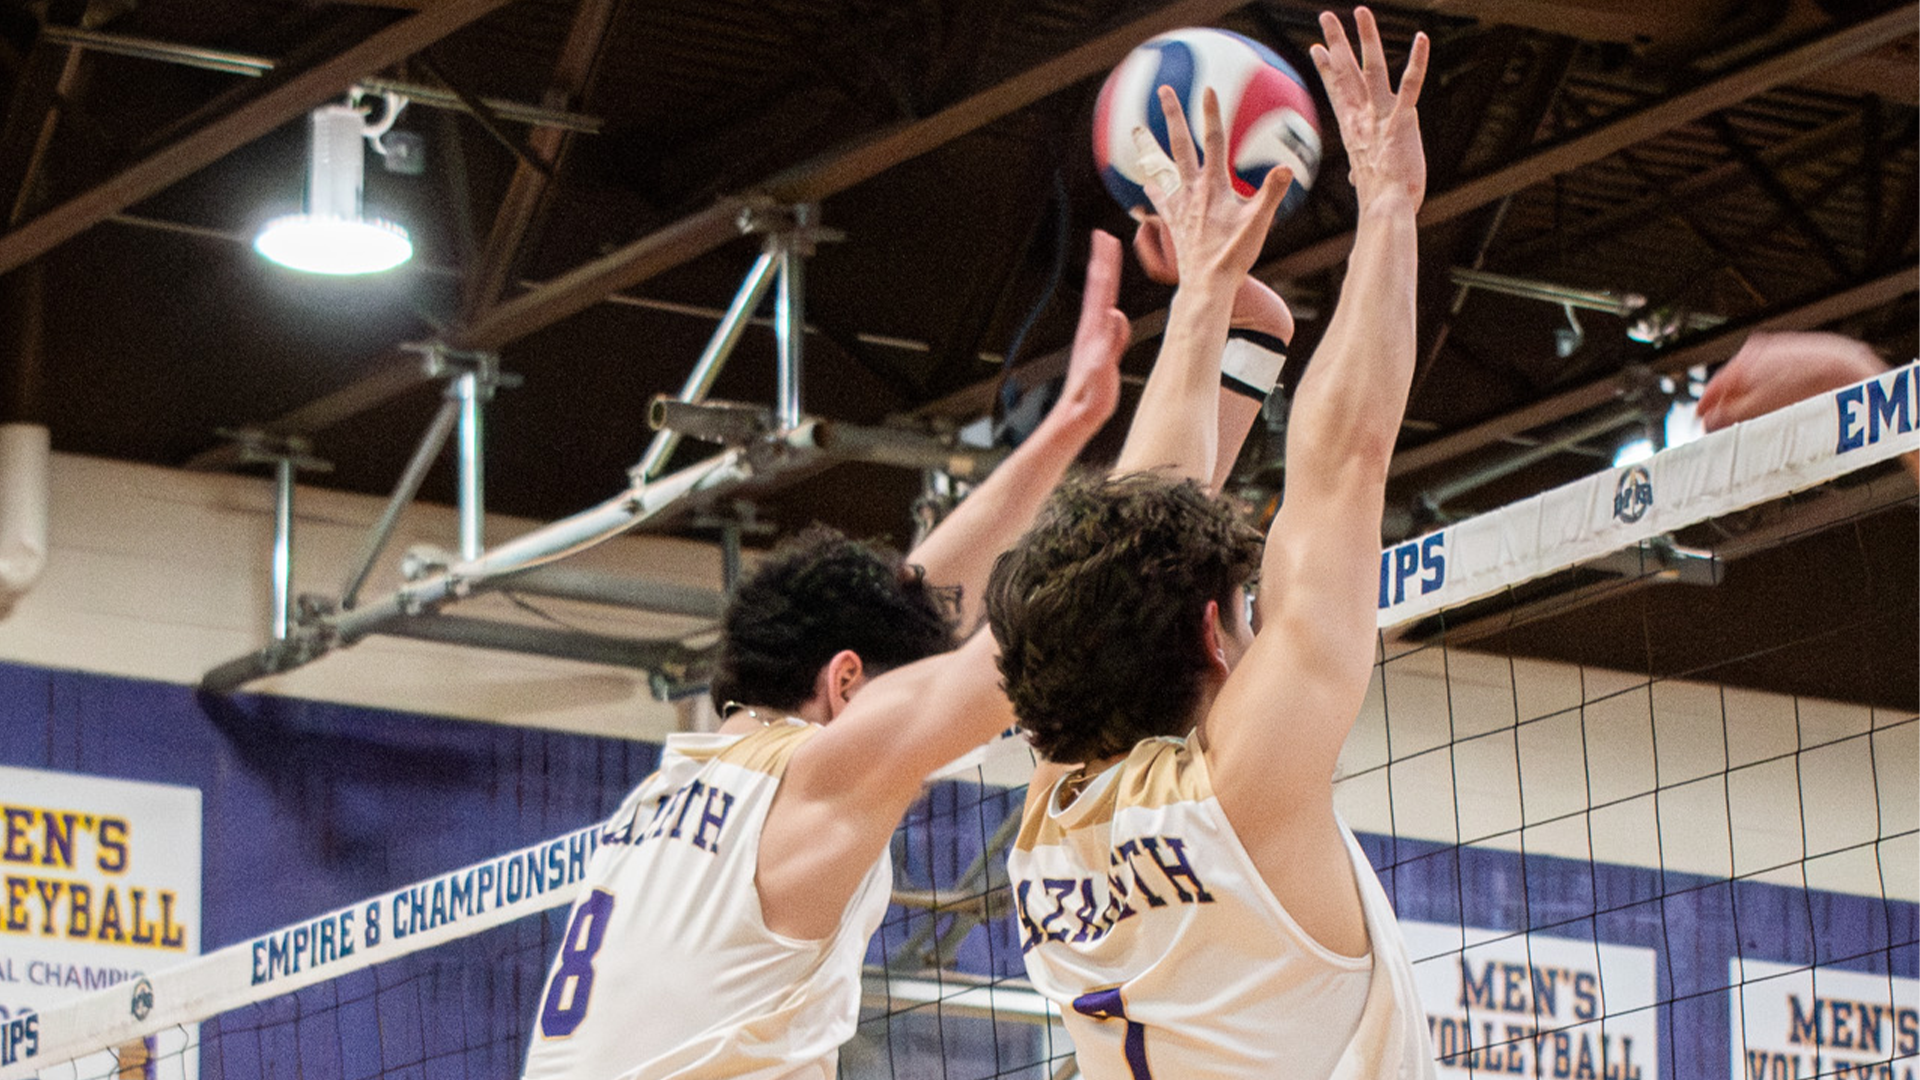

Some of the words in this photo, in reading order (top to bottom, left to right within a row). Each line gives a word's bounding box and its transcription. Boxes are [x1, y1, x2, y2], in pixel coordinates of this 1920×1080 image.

[250, 909, 356, 987] EMPIRE
[364, 900, 382, 949] 8
[392, 823, 607, 941] CHAMPIONSHI
[541, 887, 615, 1041] 8
[1458, 957, 1598, 1021] MEN'S
[1787, 992, 1919, 1056] MEN'S
